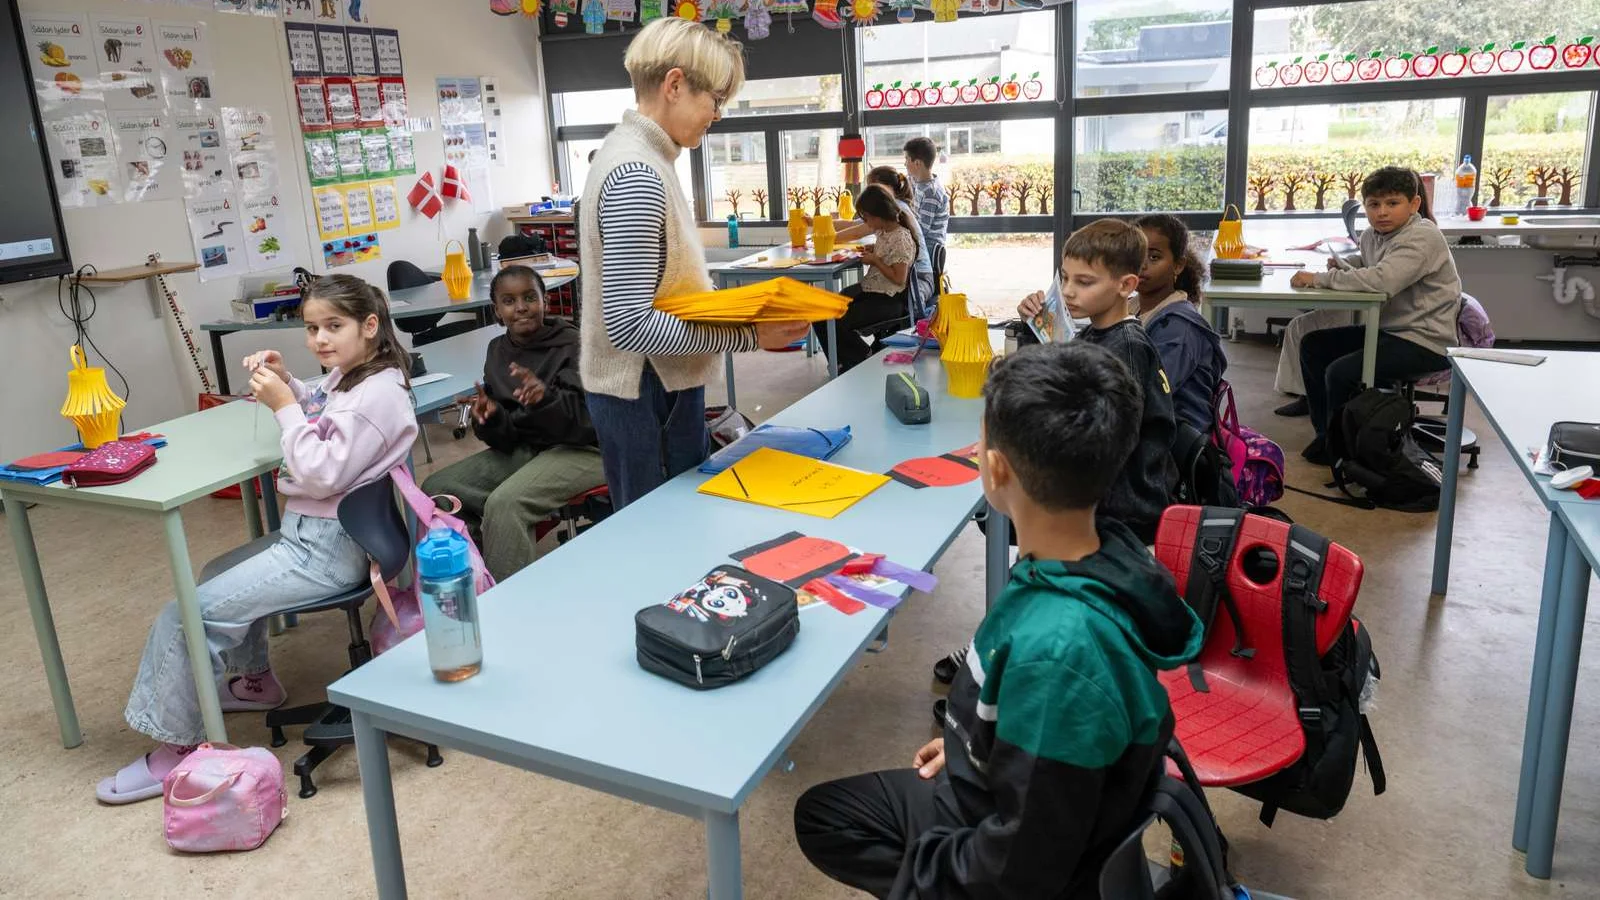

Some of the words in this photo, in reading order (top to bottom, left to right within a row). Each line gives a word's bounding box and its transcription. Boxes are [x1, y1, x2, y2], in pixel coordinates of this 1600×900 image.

[72, 24, 80, 34] a
[136, 25, 143, 35] e
[152, 118, 160, 128] u
[207, 118, 215, 130] y
